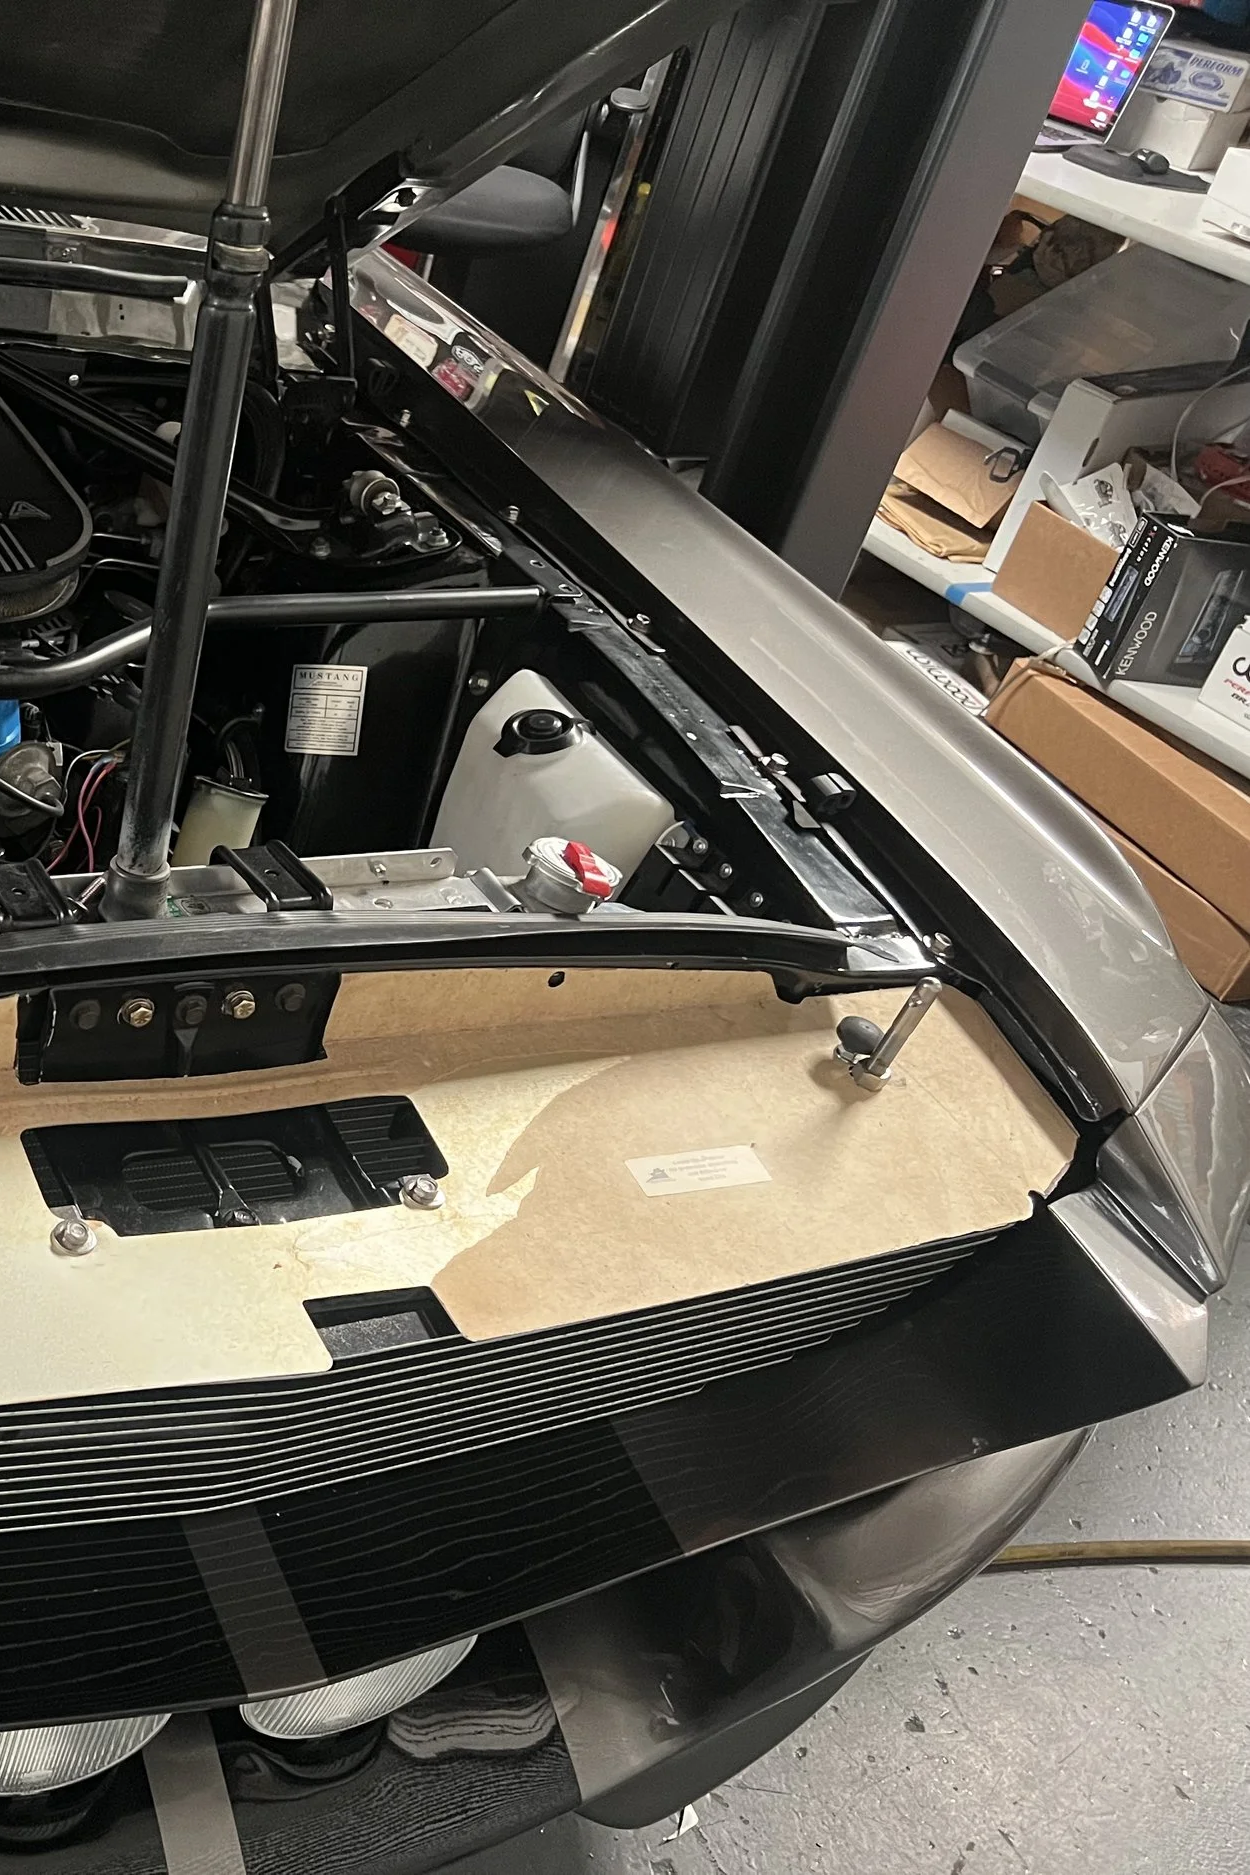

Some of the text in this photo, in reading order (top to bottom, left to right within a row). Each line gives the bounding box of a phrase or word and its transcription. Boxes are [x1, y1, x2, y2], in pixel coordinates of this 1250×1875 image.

[1143, 535, 1174, 587] KENWOOD
[1115, 611, 1158, 676] KENWOOD
[299, 671, 359, 681] MUSTANG
